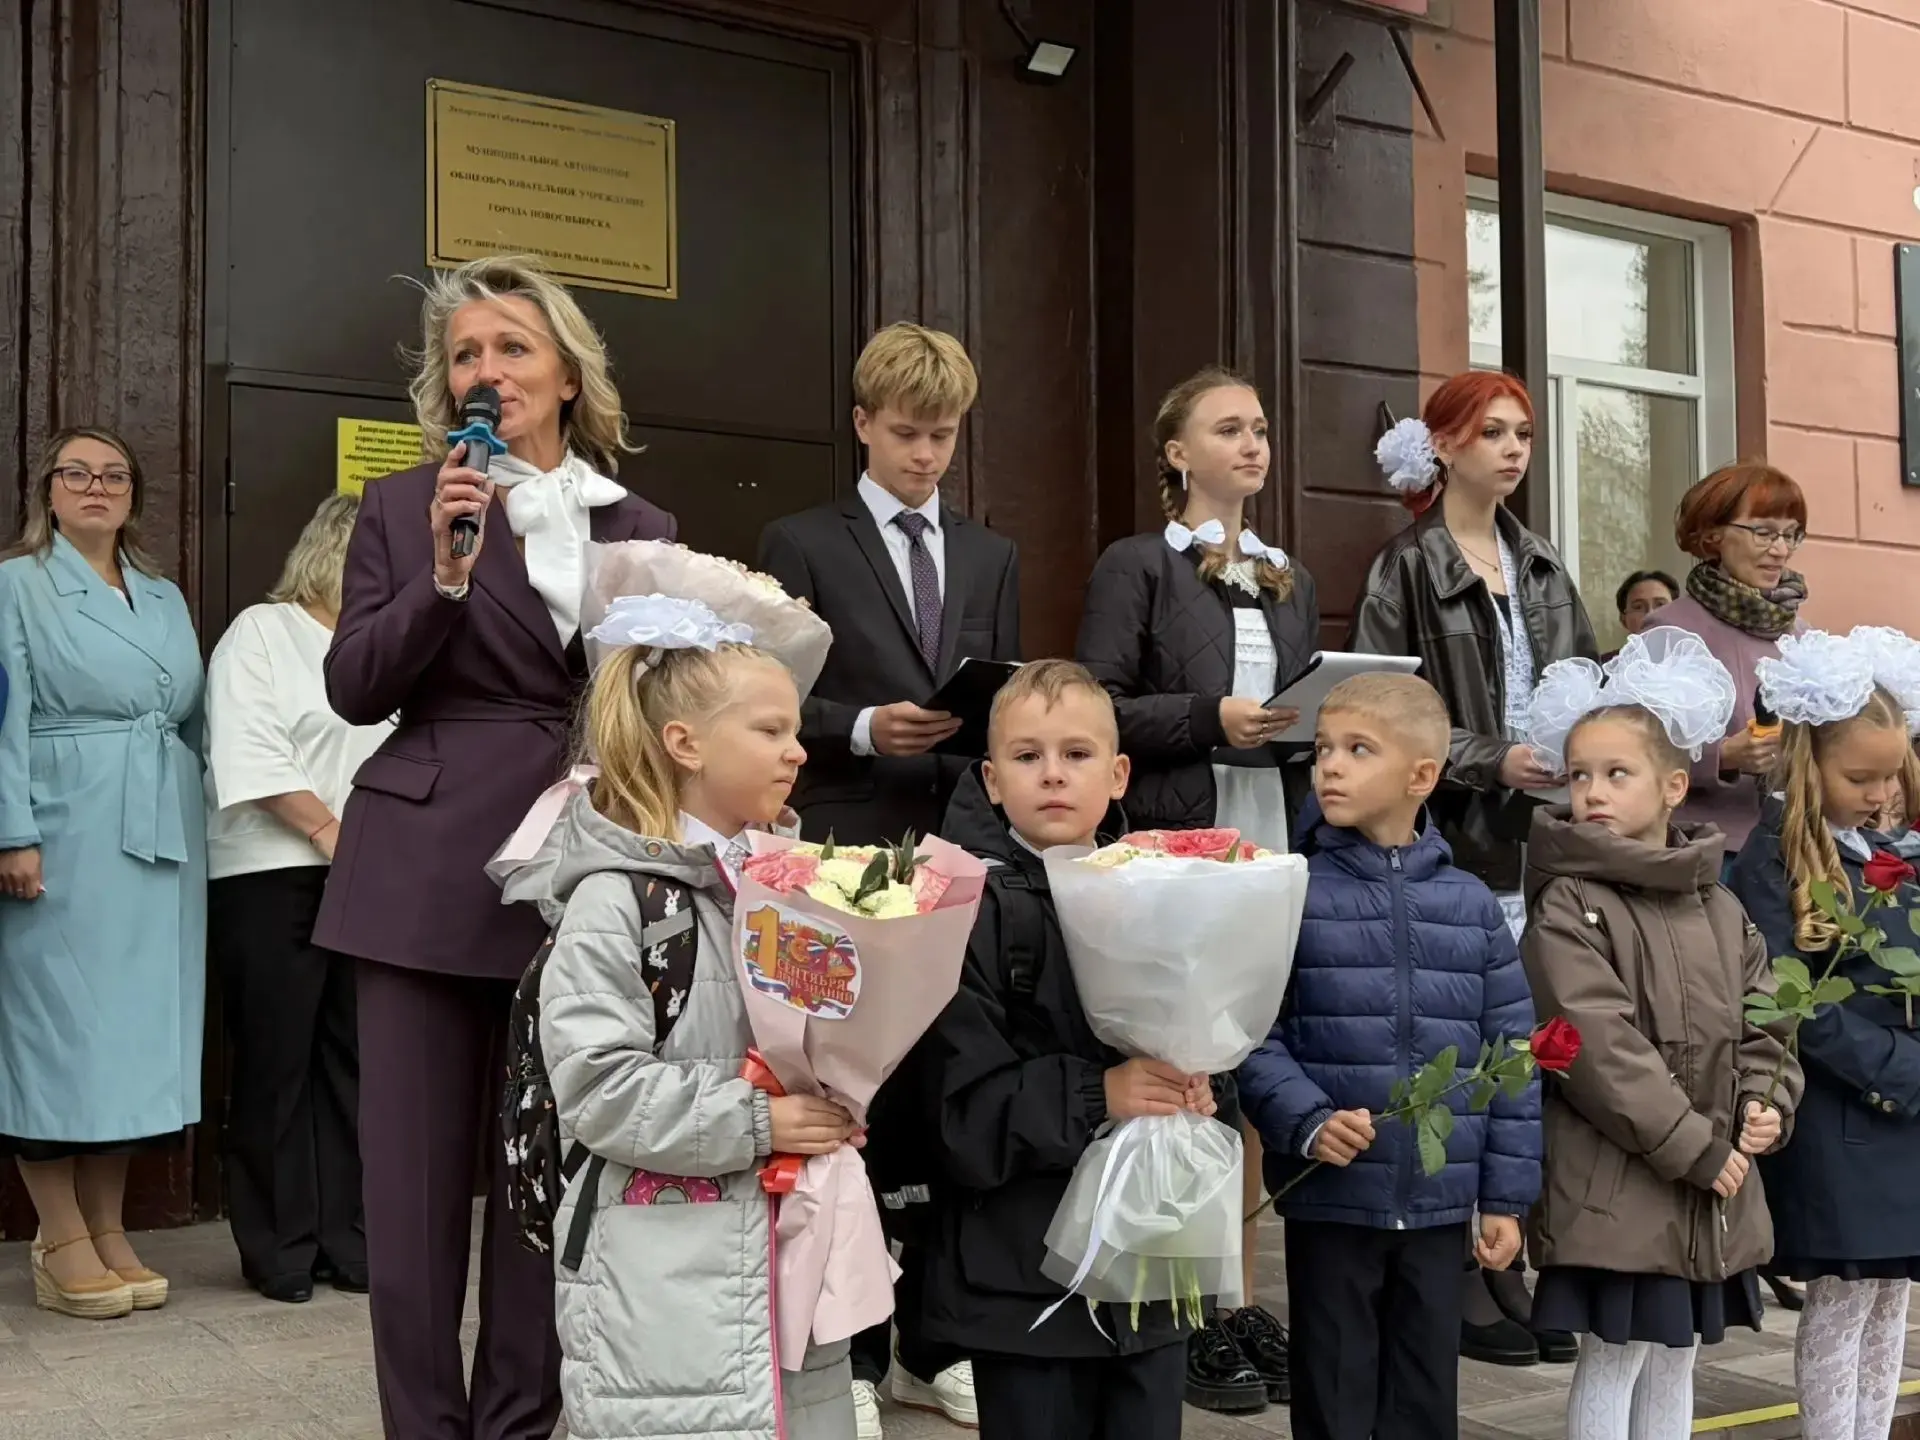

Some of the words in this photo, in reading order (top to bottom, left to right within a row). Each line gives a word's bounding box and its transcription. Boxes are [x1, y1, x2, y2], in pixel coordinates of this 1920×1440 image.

[466, 144, 560, 168] МУНИЦИПАЛЬНОЕ
[450, 171, 577, 197] ОБЩЕОБРАЗОВАТЕЛЬНОЕ
[488, 203, 528, 217] ГОРОДА
[530, 209, 612, 230] НОВОСИБИРСКА
[746, 904, 780, 978] 1
[775, 971, 802, 990] ДЕНЬ
[803, 982, 854, 1003] ЗНАНИЙ
[777, 958, 847, 992] СЕНТЯБРЯ
